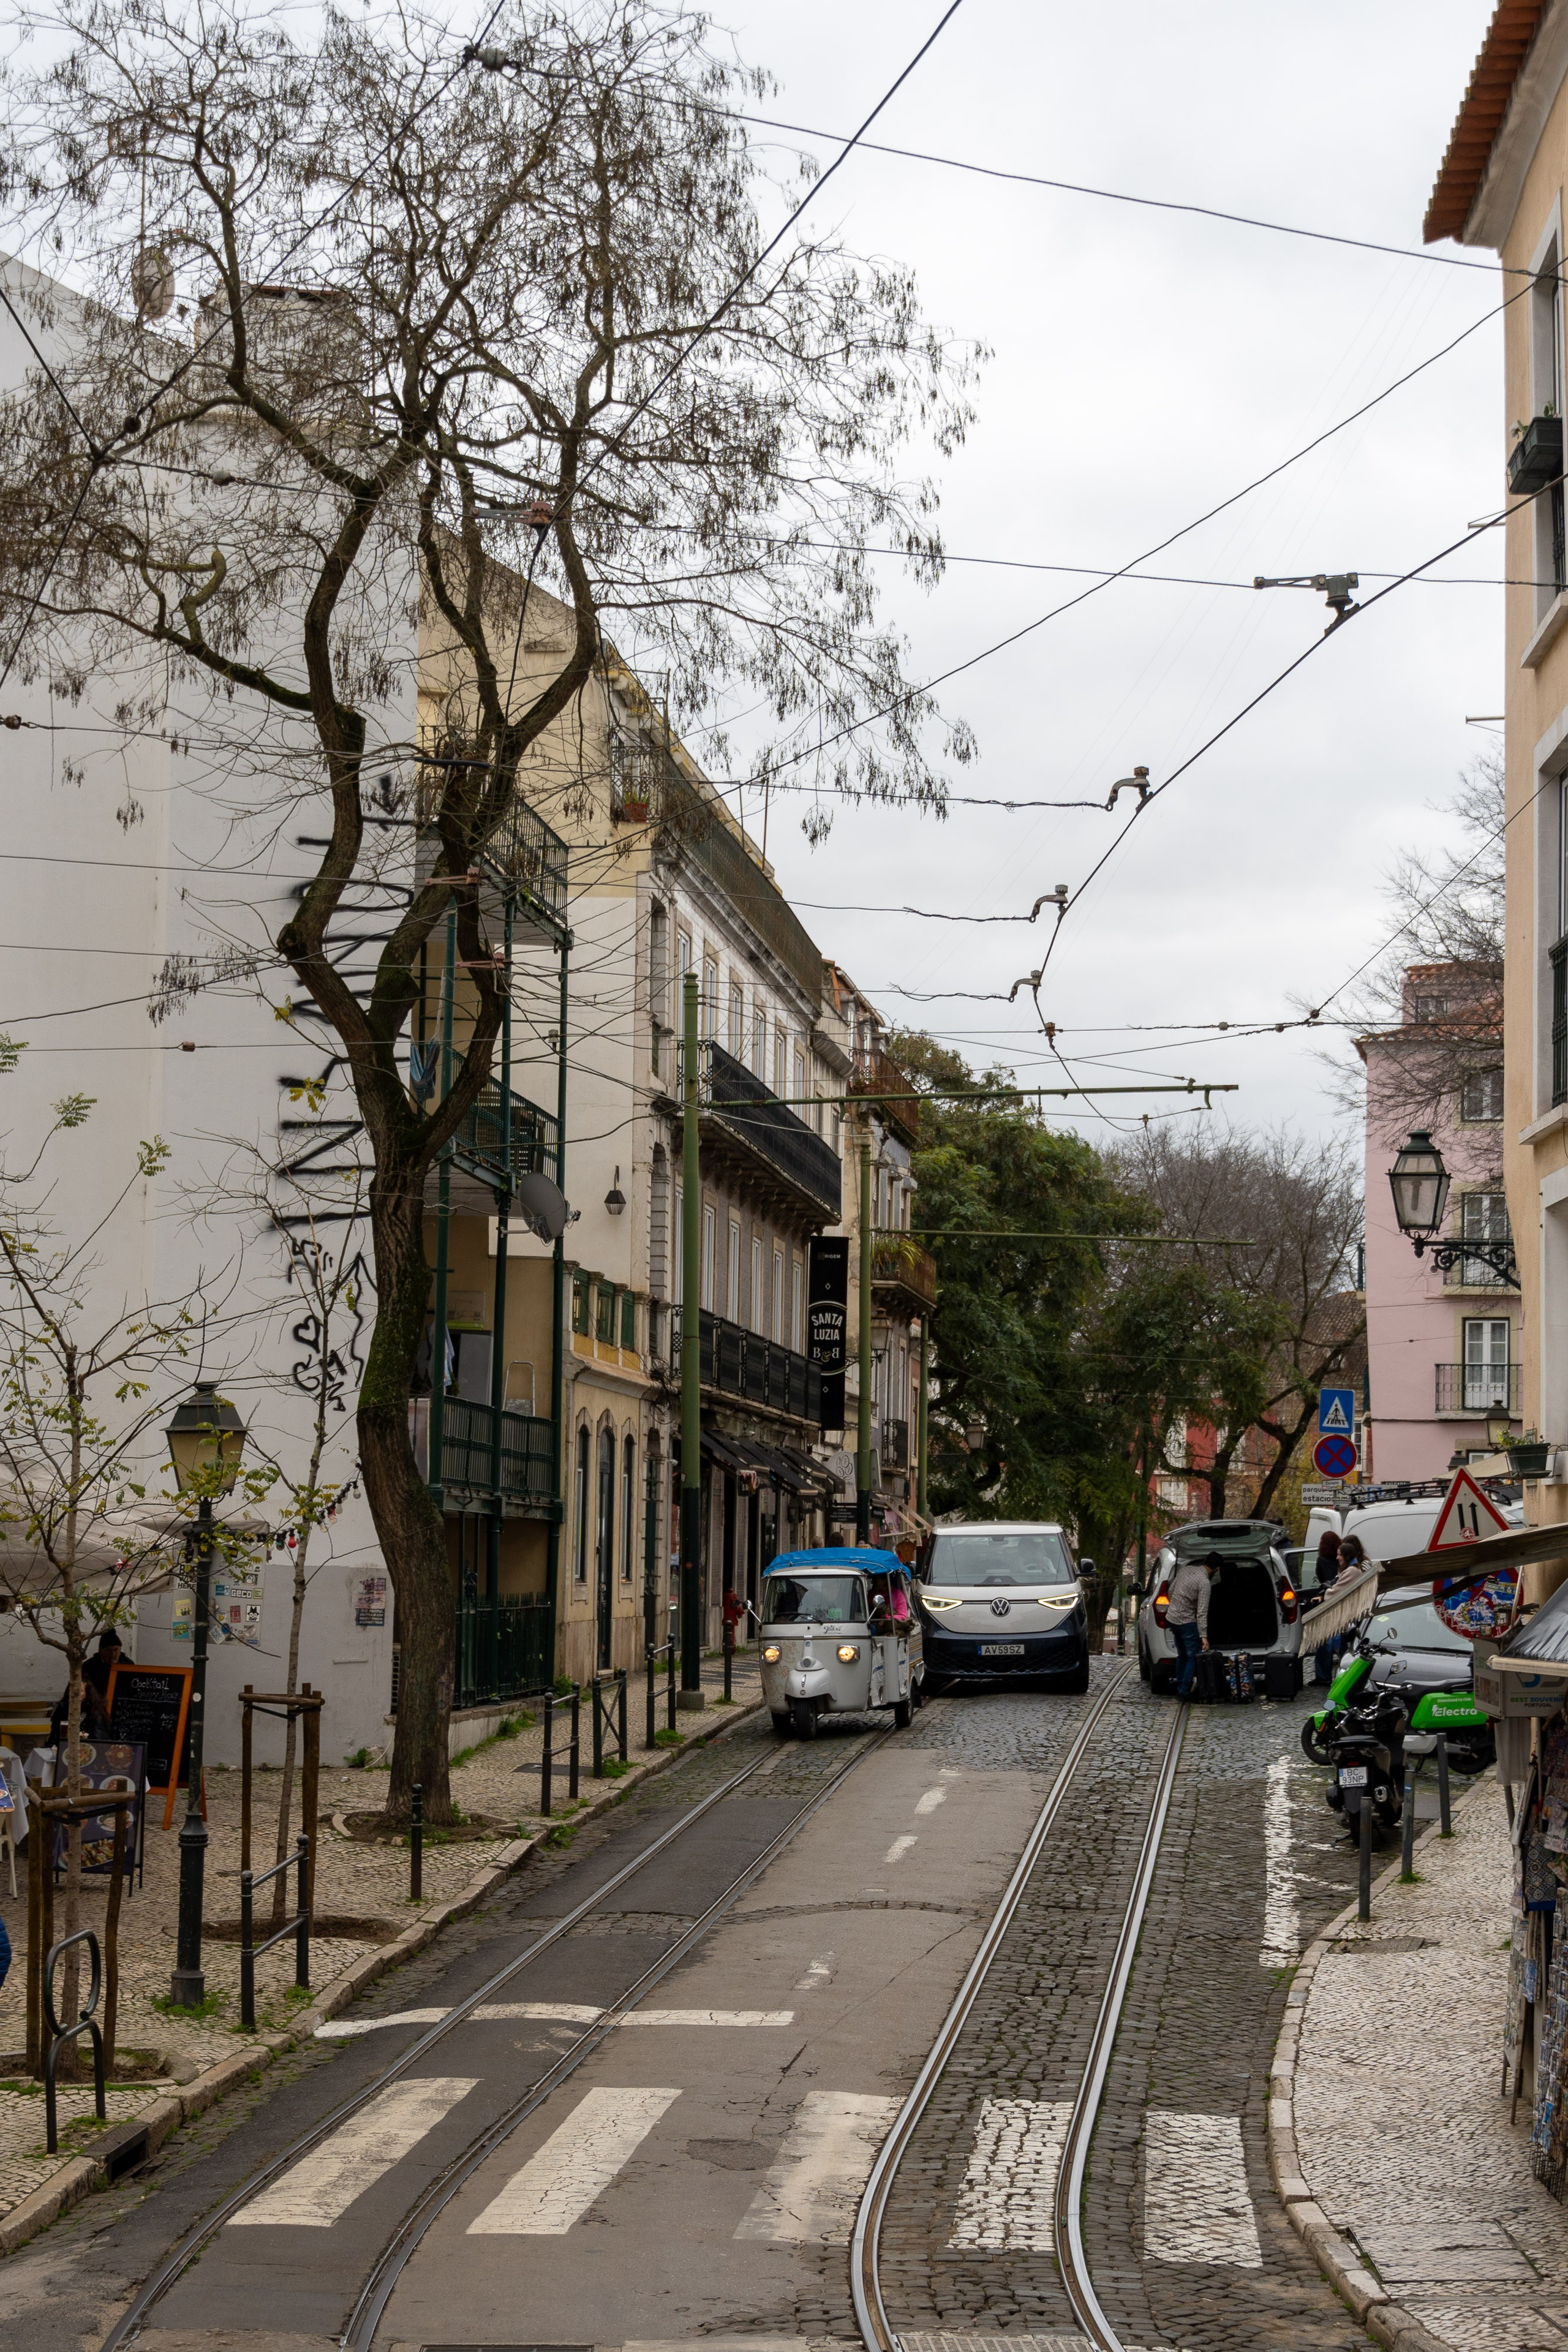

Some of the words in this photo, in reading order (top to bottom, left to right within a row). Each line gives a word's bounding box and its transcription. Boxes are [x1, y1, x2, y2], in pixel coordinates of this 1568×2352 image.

[811, 1313, 843, 1327] SANTA
[814, 1329, 840, 1340] LUZIA
[813, 1347, 840, 1362] B&B
[984, 1645, 1022, 1654] AV59SZ
[1434, 1706, 1477, 1716] Electra
[1342, 1775, 1364, 1784] 93NP
